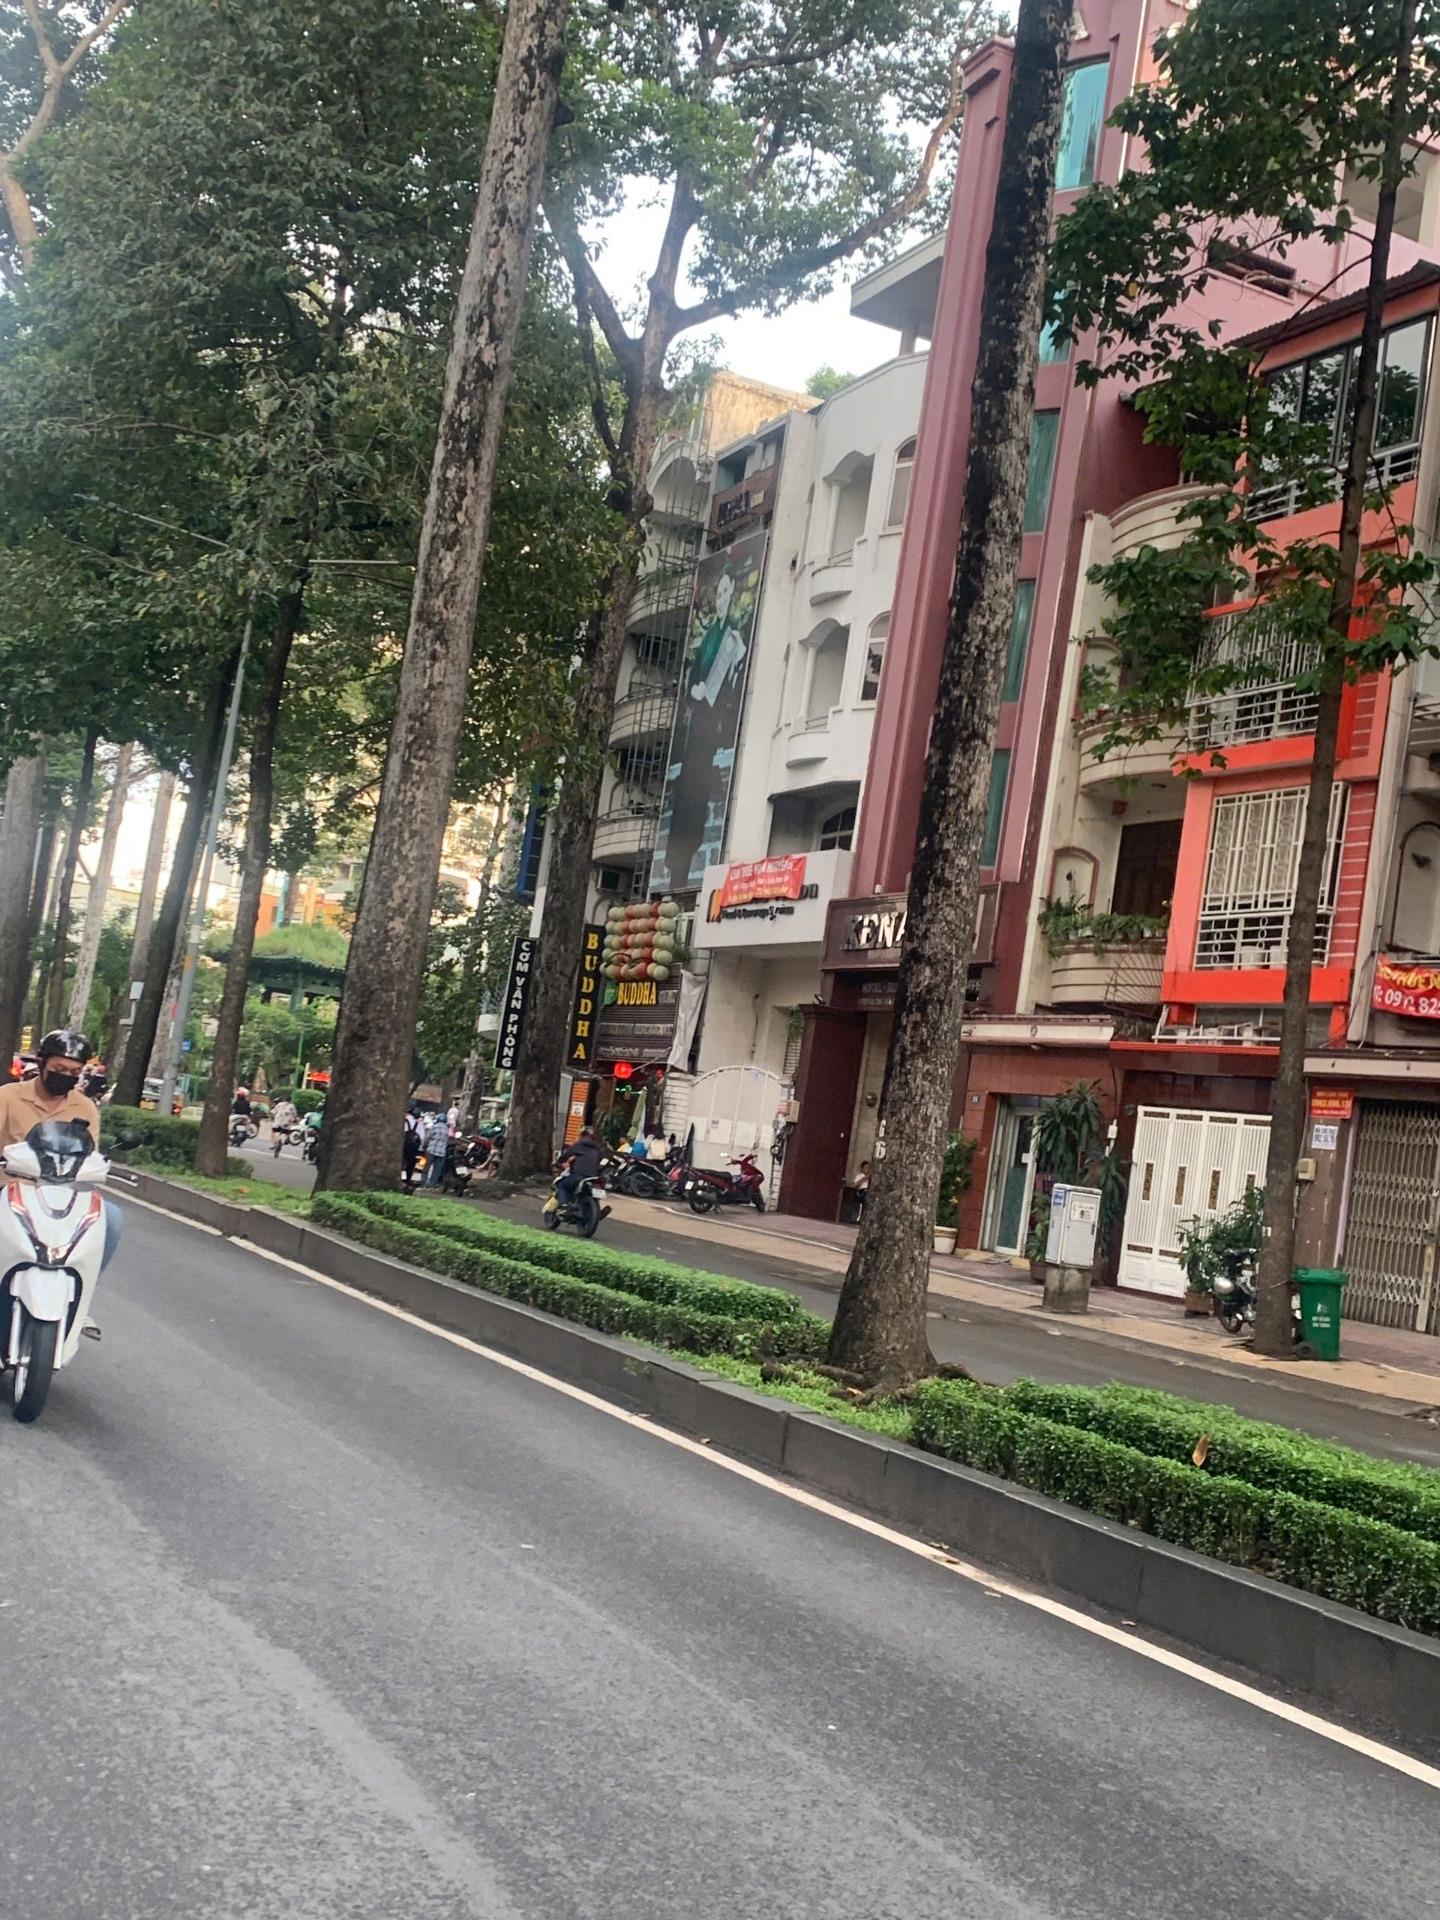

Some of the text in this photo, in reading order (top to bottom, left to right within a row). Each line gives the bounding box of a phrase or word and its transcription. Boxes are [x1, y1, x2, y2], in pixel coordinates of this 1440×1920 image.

[511, 976, 526, 1010] VĂN
[573, 932, 599, 1060] BUDDHA
[617, 982, 657, 1005] BUDDHA
[1419, 997, 1440, 1015] 82
[502, 1013, 519, 1068] PHÒNG
